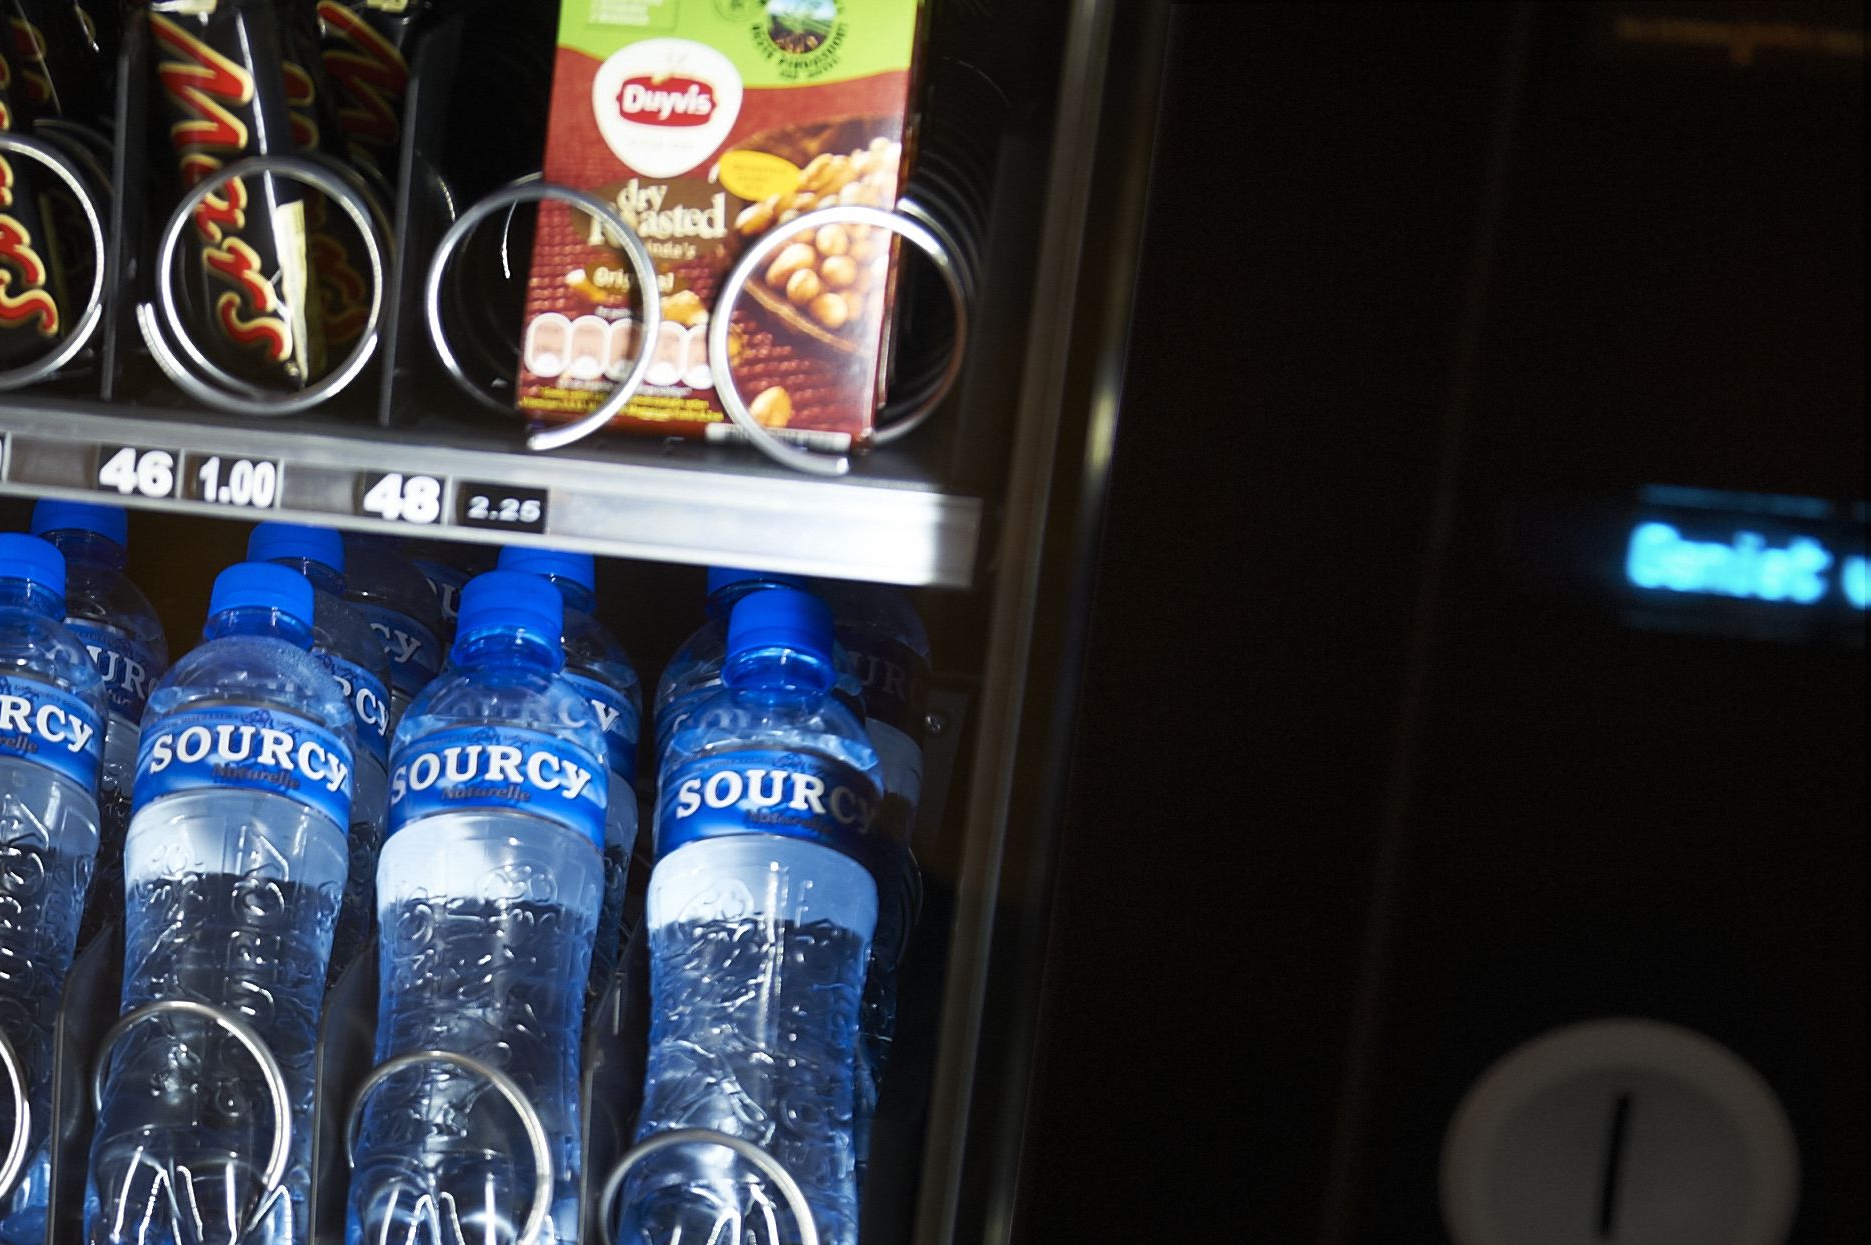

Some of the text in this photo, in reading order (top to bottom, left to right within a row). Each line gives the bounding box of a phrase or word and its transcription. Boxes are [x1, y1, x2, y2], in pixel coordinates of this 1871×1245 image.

[621, 82, 716, 120] Duyvis
[149, 10, 295, 363] Mars
[616, 178, 669, 213] dry
[592, 266, 675, 293] Orial
[99, 448, 276, 507] 46 1.00
[363, 473, 542, 524] 48 2.25
[149, 725, 351, 793] SOURCY
[210, 760, 302, 791] Naturelle
[390, 744, 592, 806] SOURCY
[675, 767, 877, 836] SOURCY
